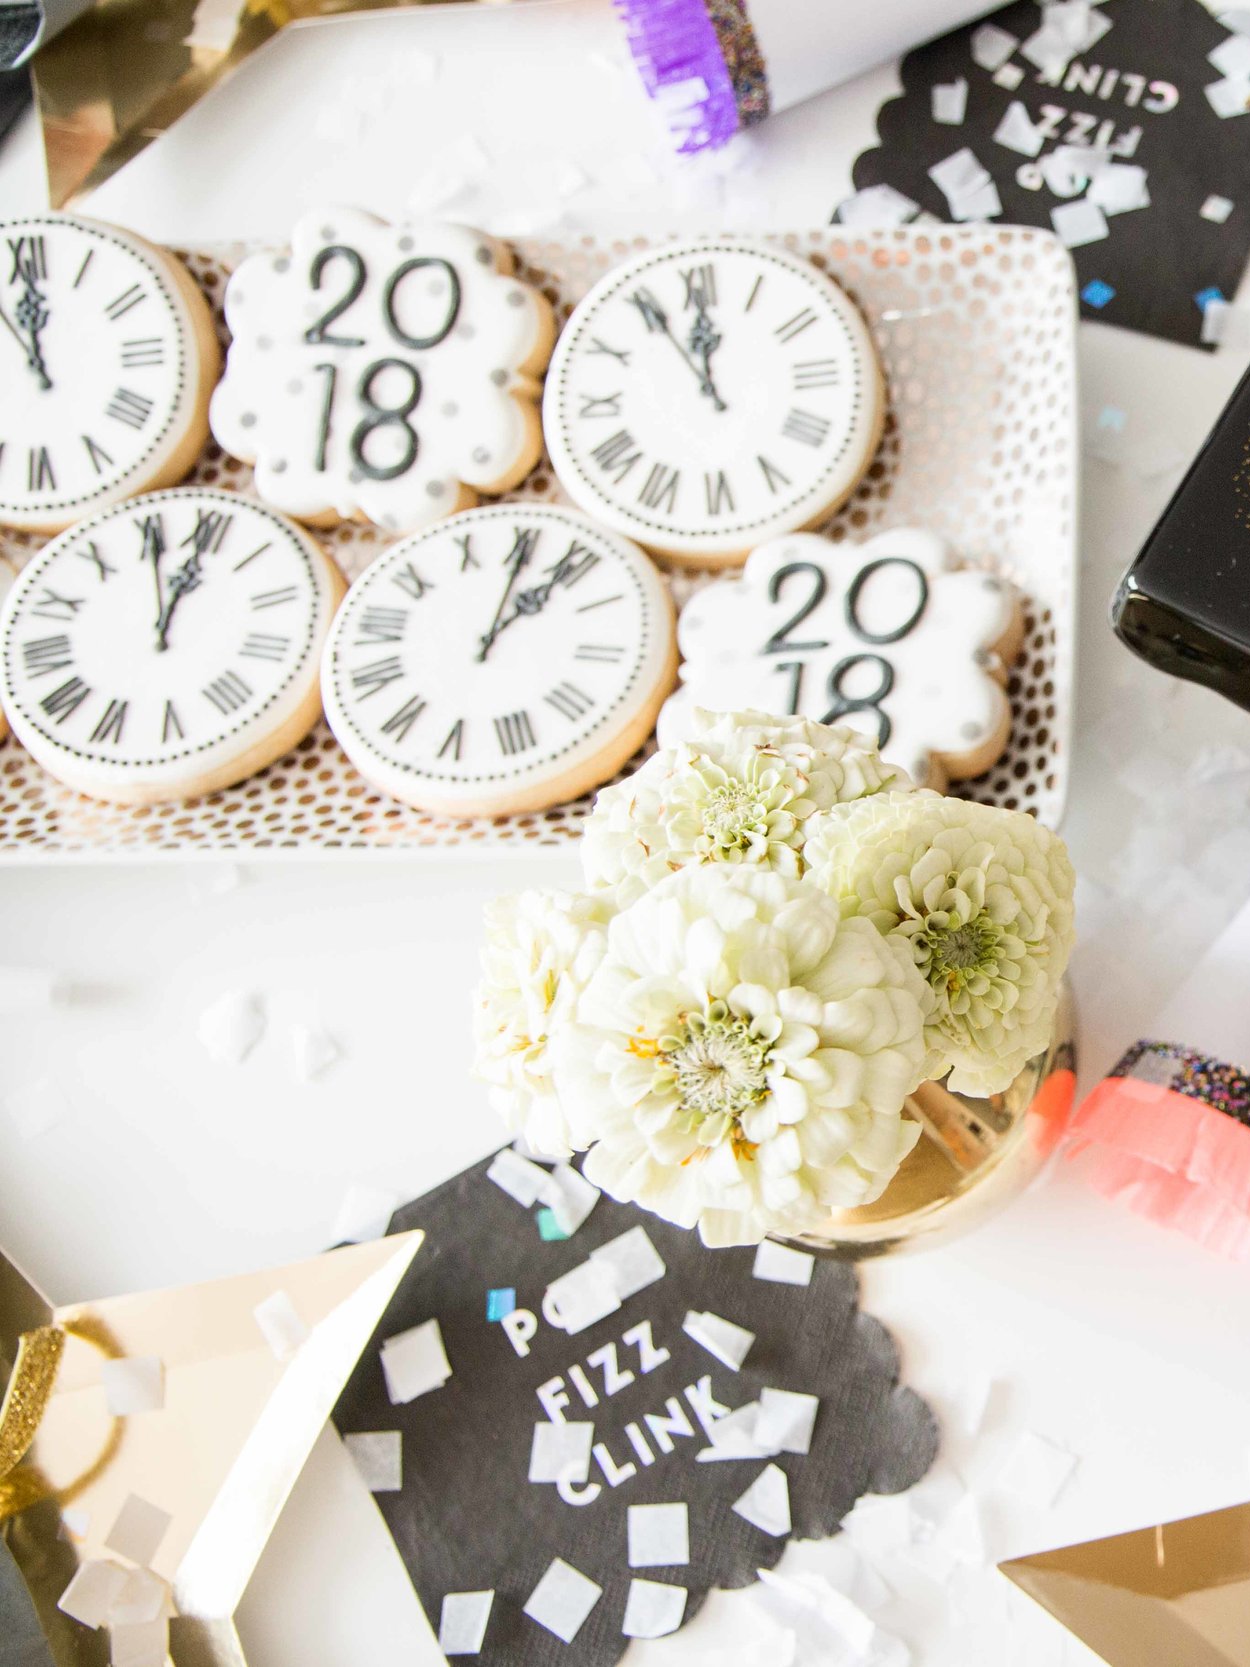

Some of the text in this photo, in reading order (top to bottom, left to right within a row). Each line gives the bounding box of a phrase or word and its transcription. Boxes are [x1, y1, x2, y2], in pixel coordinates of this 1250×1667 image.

[305, 245, 462, 350] 20
[314, 358, 422, 481] 18
[761, 557, 929, 653] 20
[775, 653, 895, 750] 18
[535, 1319, 671, 1425] FIZZ
[556, 1375, 732, 1506] CLINK
